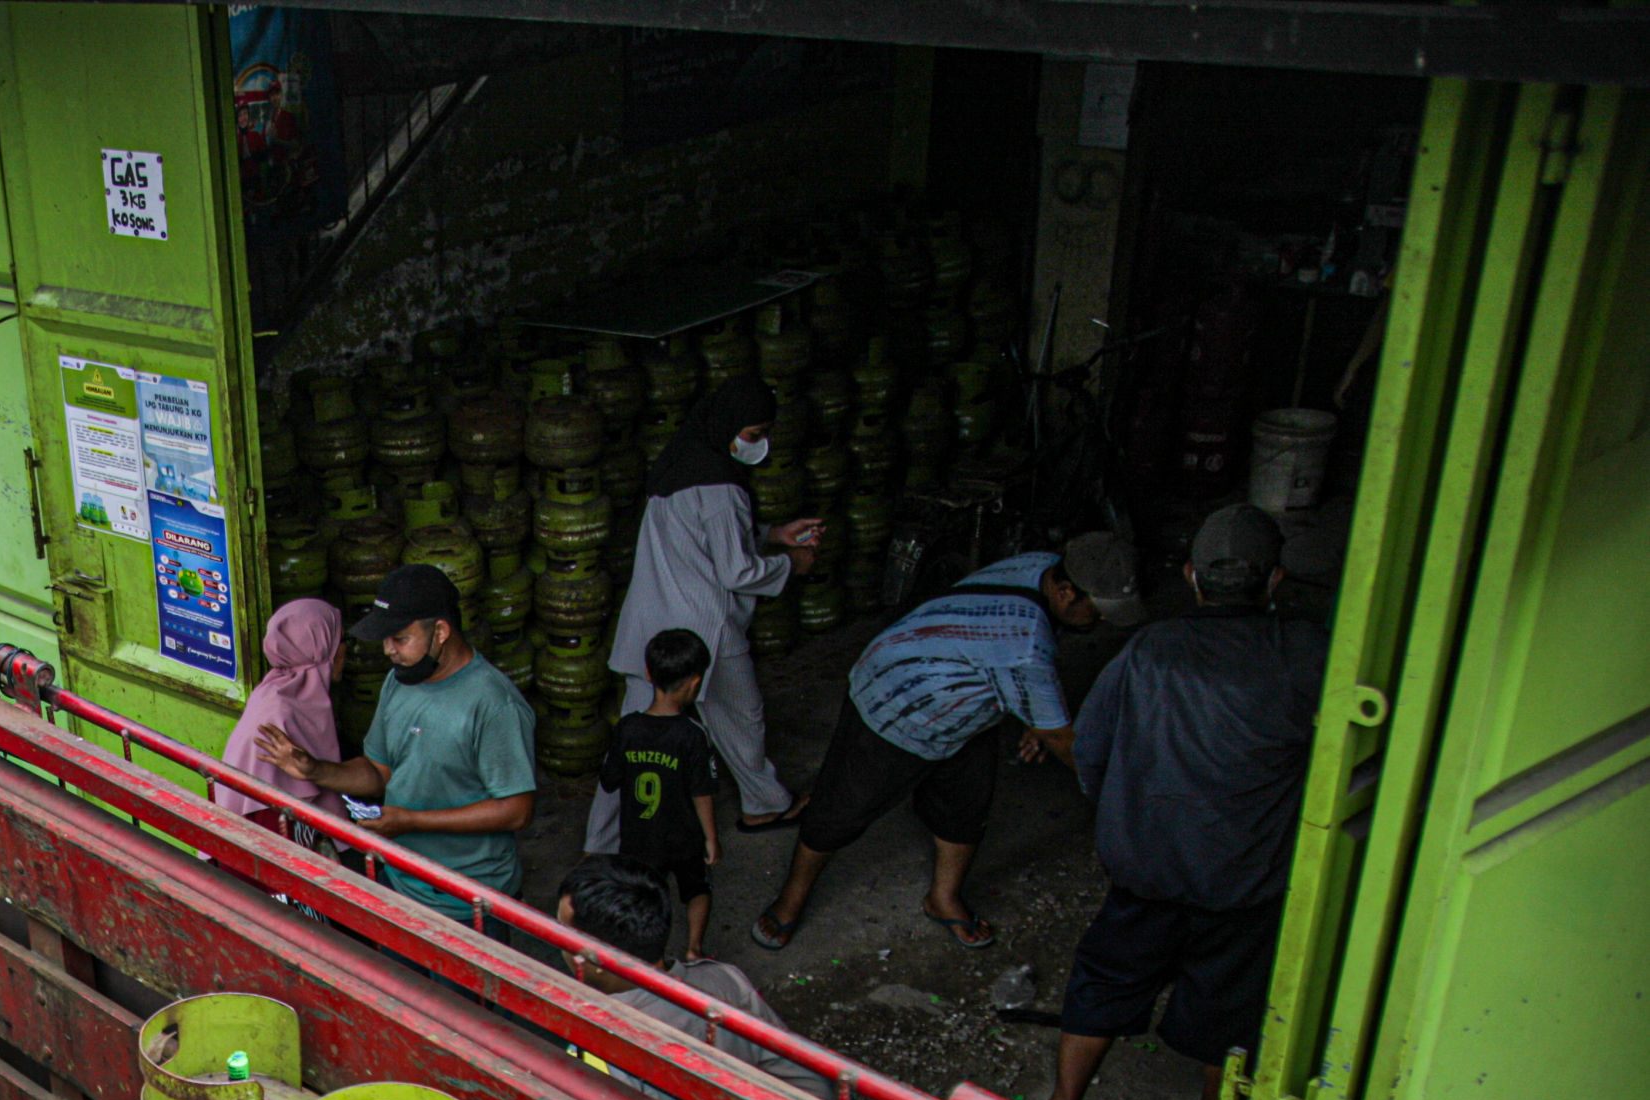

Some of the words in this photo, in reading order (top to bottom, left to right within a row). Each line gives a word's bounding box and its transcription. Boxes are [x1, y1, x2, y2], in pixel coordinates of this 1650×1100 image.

[111, 157, 148, 188] GAS
[111, 208, 155, 231] KOSONG
[145, 400, 157, 410] LPG
[158, 403, 184, 414] TABUNG
[191, 408, 202, 418] KG
[154, 393, 189, 407] PEMBELIAN
[155, 411, 191, 429] WAJIB
[145, 424, 193, 440] MENUNJUKKAN
[194, 432, 208, 442] KTP
[165, 531, 210, 552] DILARANG
[634, 771, 662, 820] 9
